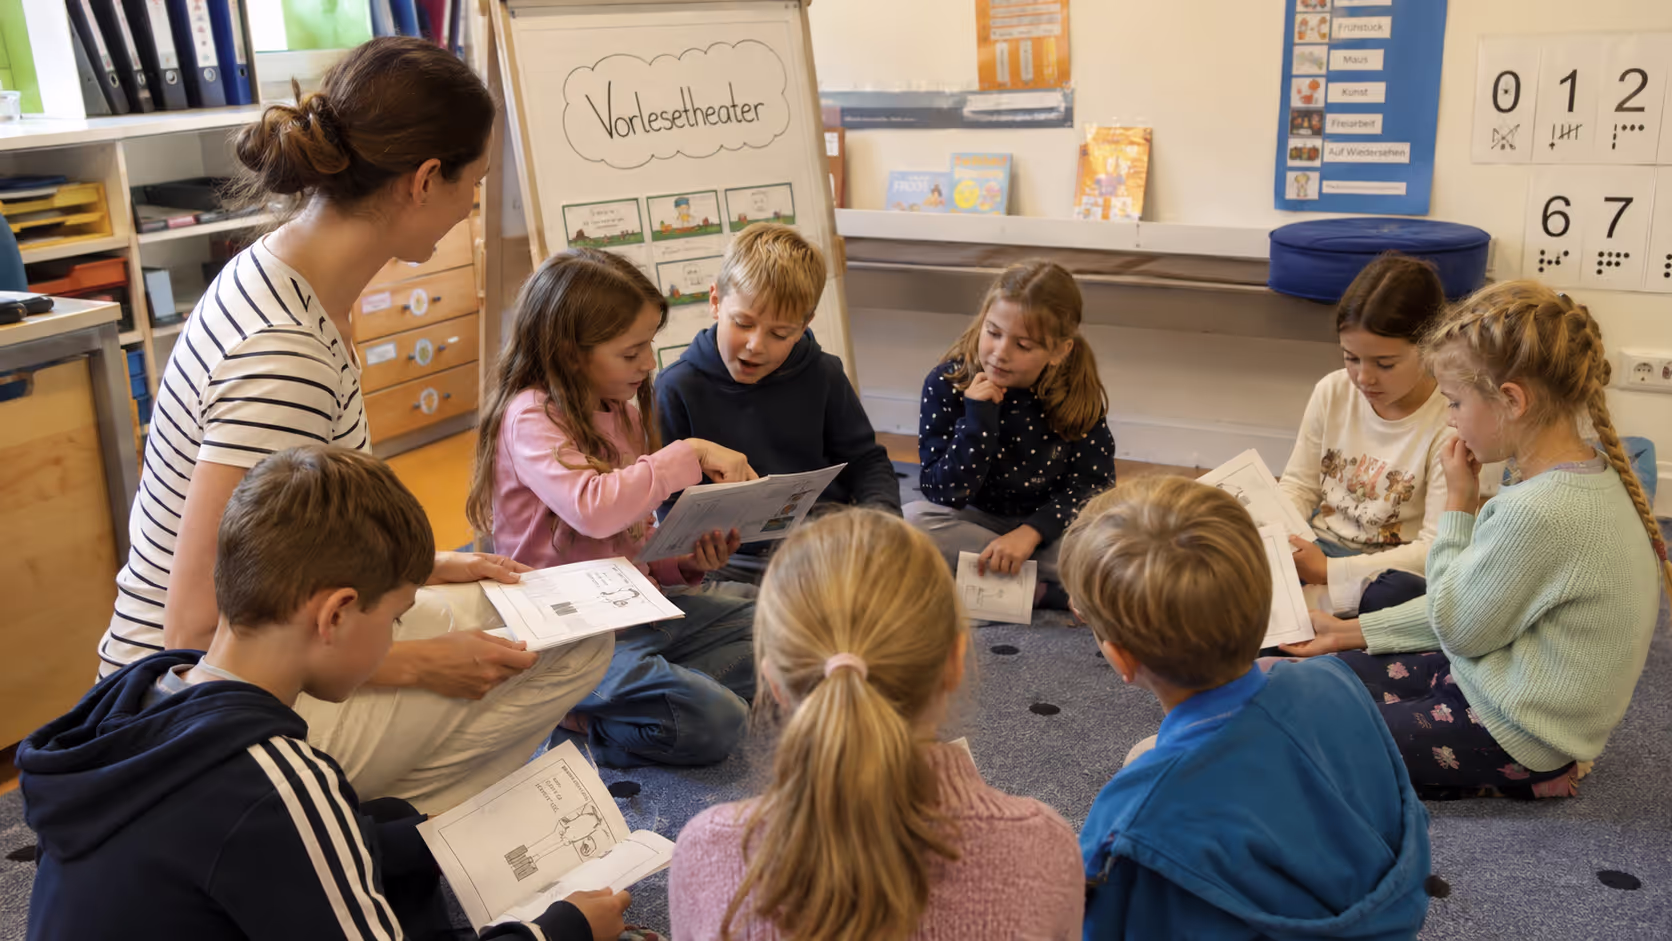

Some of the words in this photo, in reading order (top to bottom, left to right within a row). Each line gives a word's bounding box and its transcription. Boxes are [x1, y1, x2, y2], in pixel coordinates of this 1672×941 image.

[1343, 55, 1369, 65] Maus
[585, 80, 765, 139] Vorlesetheater
[1342, 88, 1369, 97] Kunst
[1492, 70, 1521, 114] 0
[1559, 69, 1578, 113] 1
[1614, 68, 1649, 113] 2
[1331, 119, 1376, 128] Freiarbeit
[1328, 147, 1345, 157] Auf
[1346, 147, 1406, 157] Wiedersehen
[1541, 195, 1571, 238] 6
[1604, 196, 1634, 239] 7
